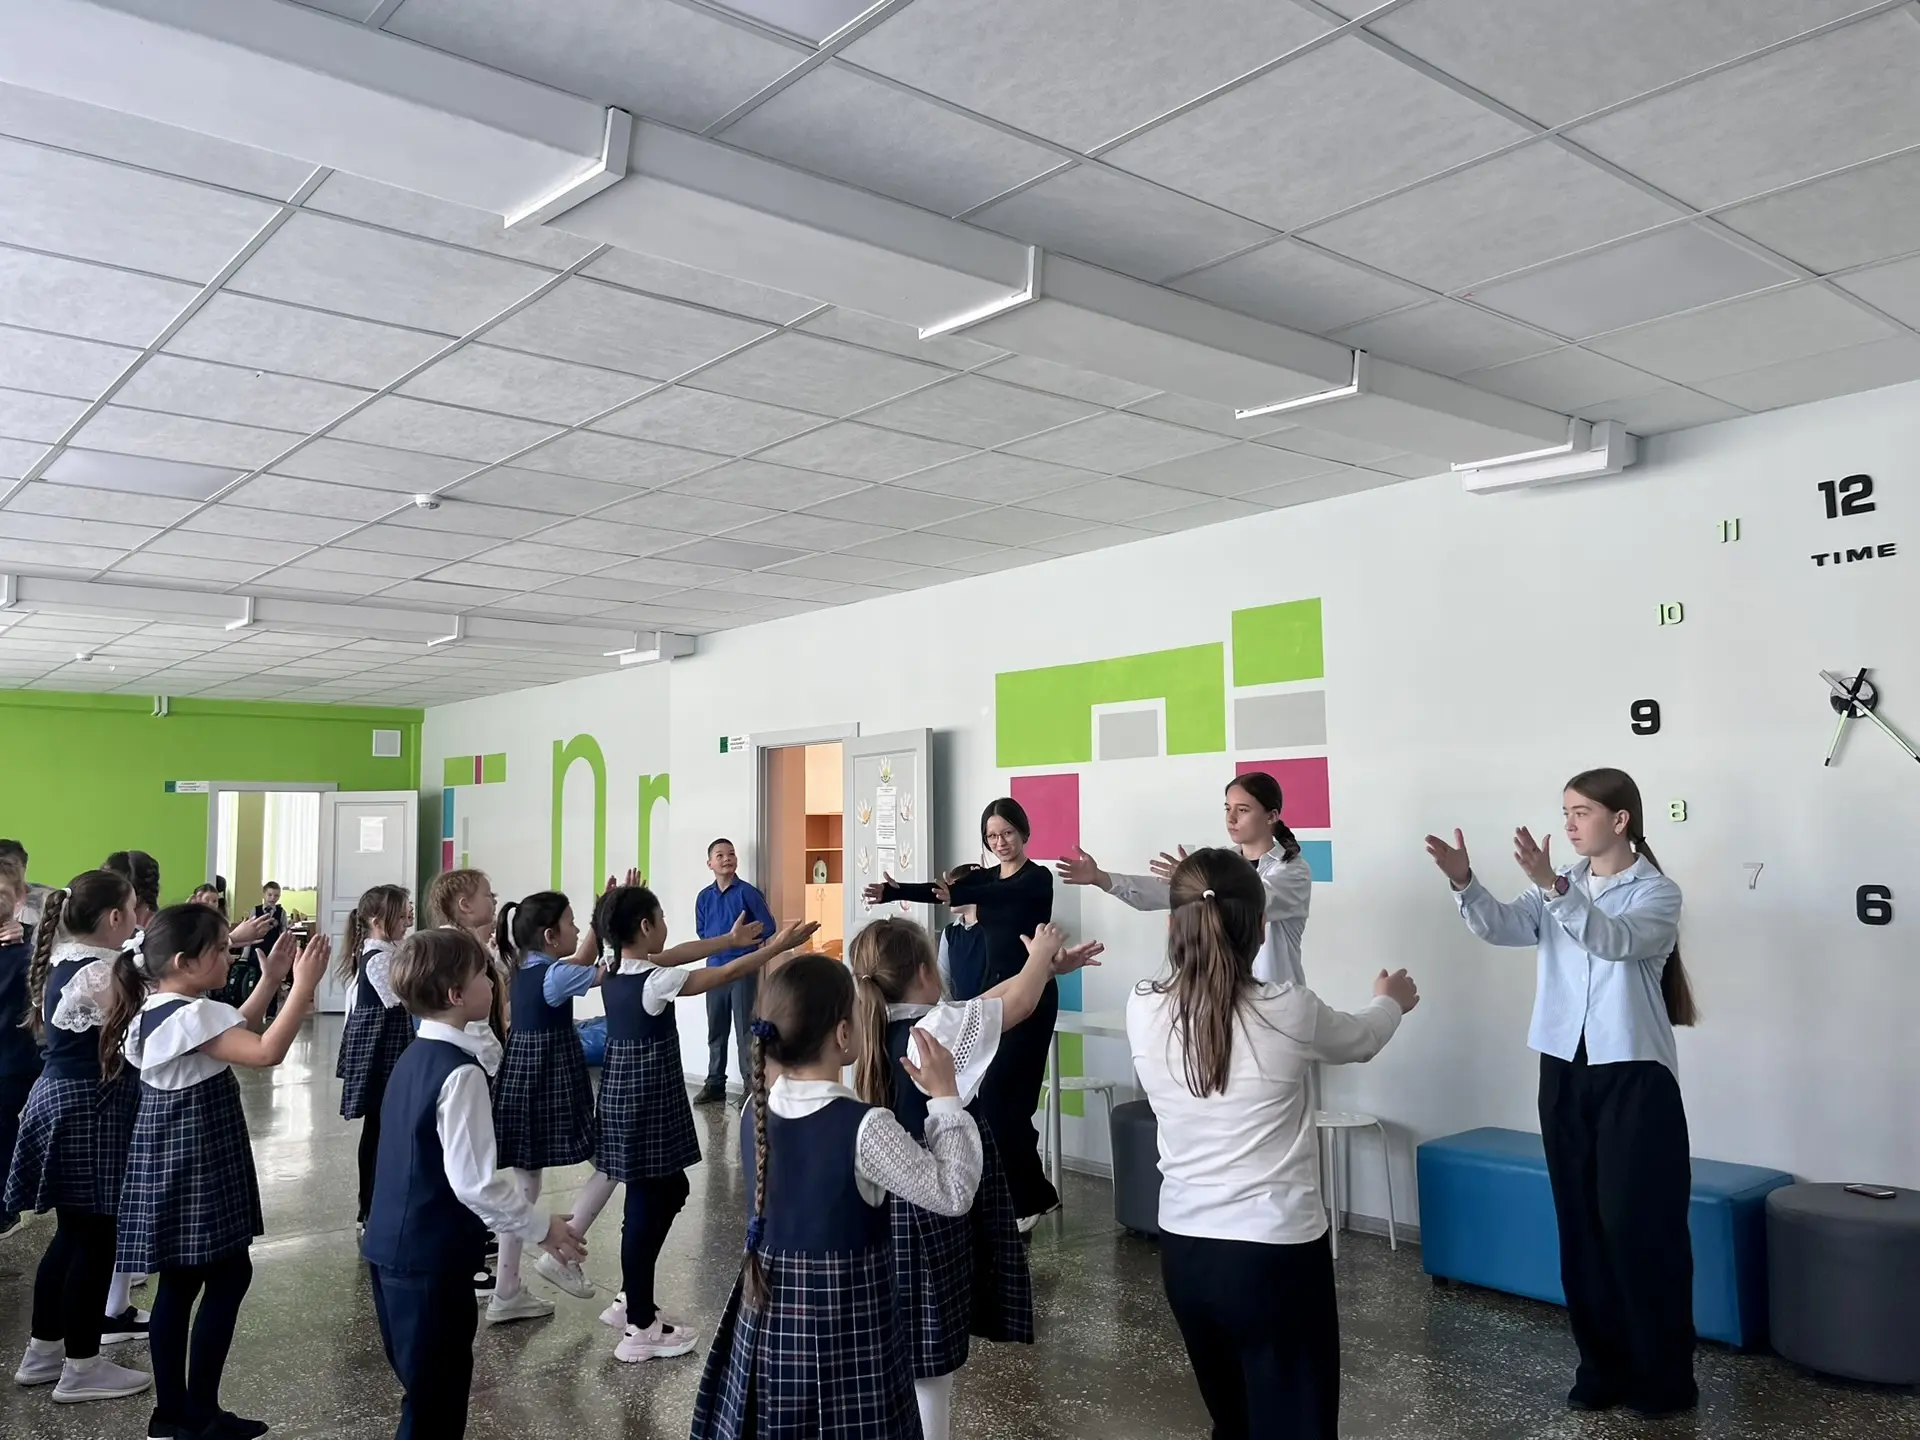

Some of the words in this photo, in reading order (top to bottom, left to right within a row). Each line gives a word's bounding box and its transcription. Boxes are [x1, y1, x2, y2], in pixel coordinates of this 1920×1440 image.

[1817, 473, 1877, 519] 12
[1716, 517, 1741, 543] 11
[1810, 542, 1897, 567] TIME
[1654, 601, 1684, 626] 10
[1629, 698, 1661, 736] 9
[1667, 799, 1688, 823] 8
[1743, 862, 1764, 890] 7
[1856, 884, 1893, 926] 6
